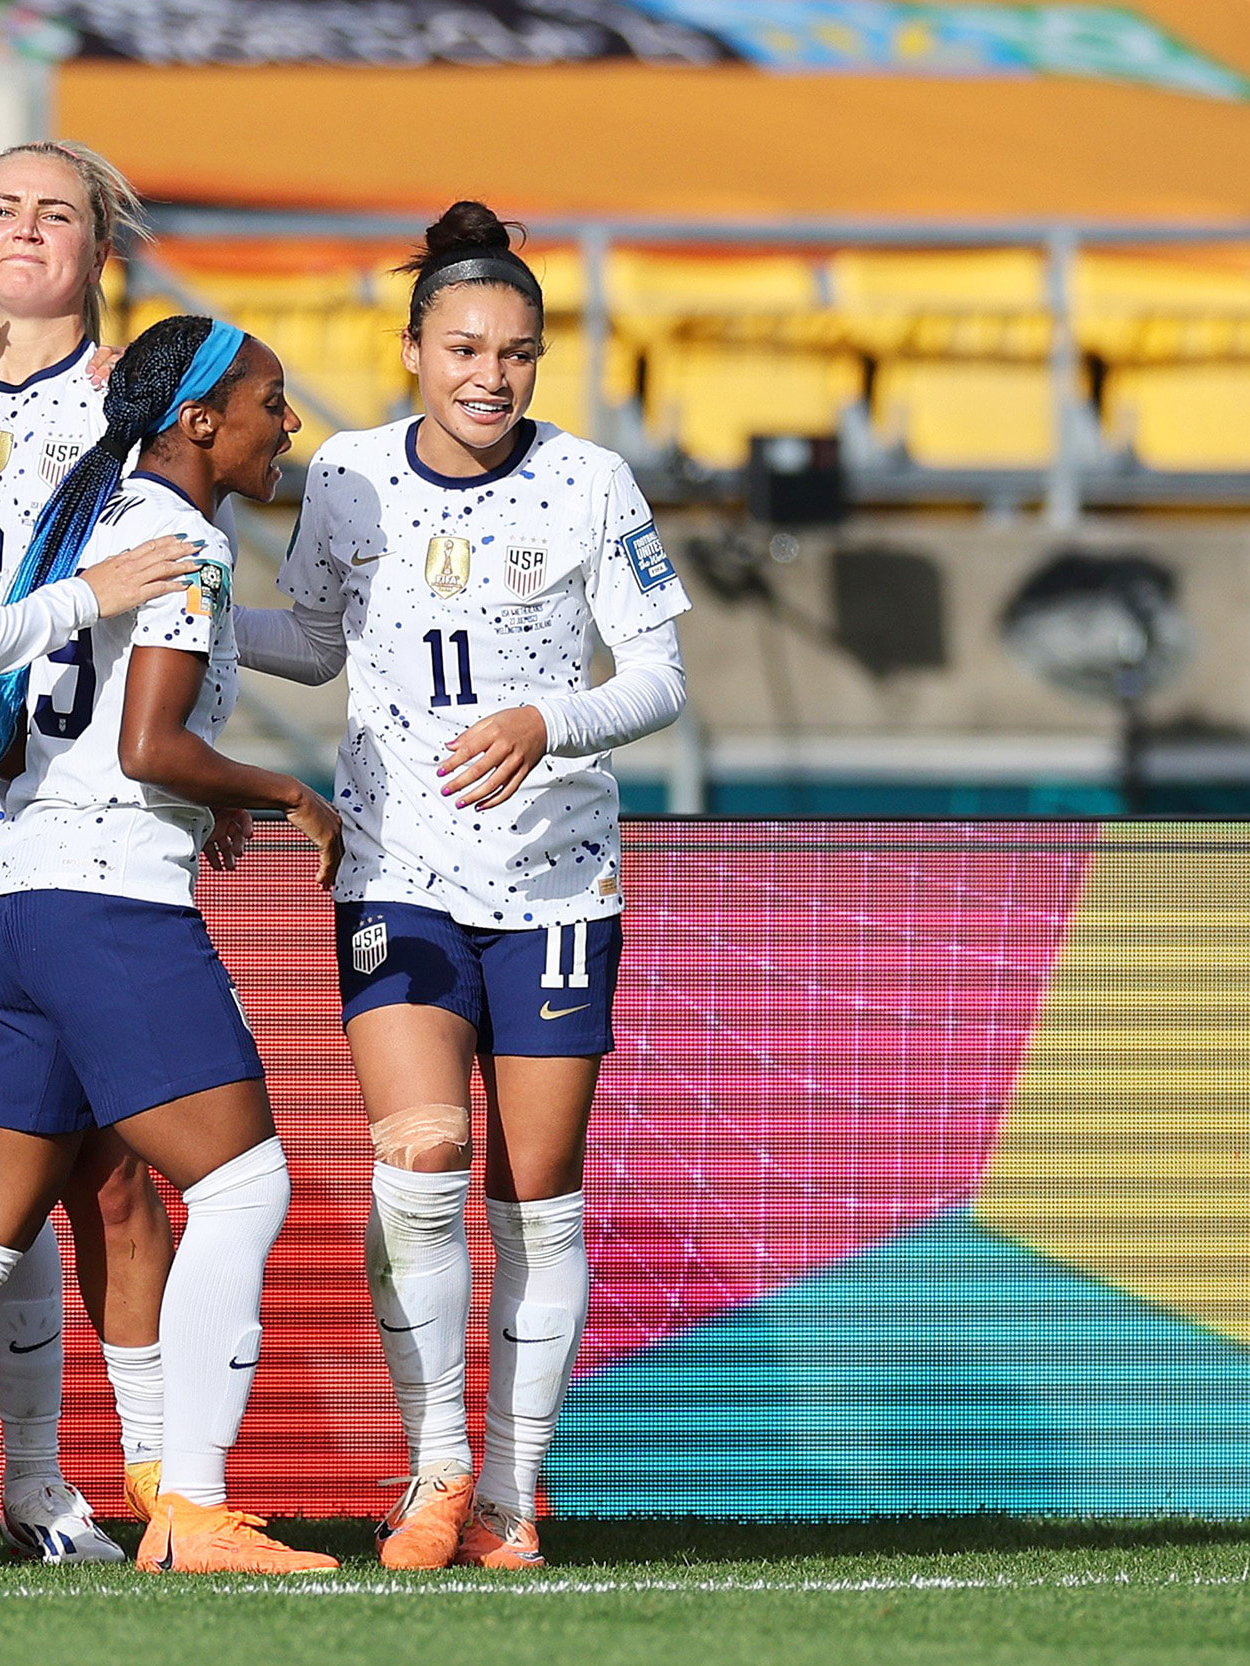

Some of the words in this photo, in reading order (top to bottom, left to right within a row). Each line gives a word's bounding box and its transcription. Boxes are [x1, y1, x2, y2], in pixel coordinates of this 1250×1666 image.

[45, 443, 79, 462] USA
[509, 549, 544, 570] USA
[435, 575, 457, 584] FIFA
[422, 629, 478, 707] 11
[355, 926, 383, 948] USA
[540, 922, 589, 988] 11
